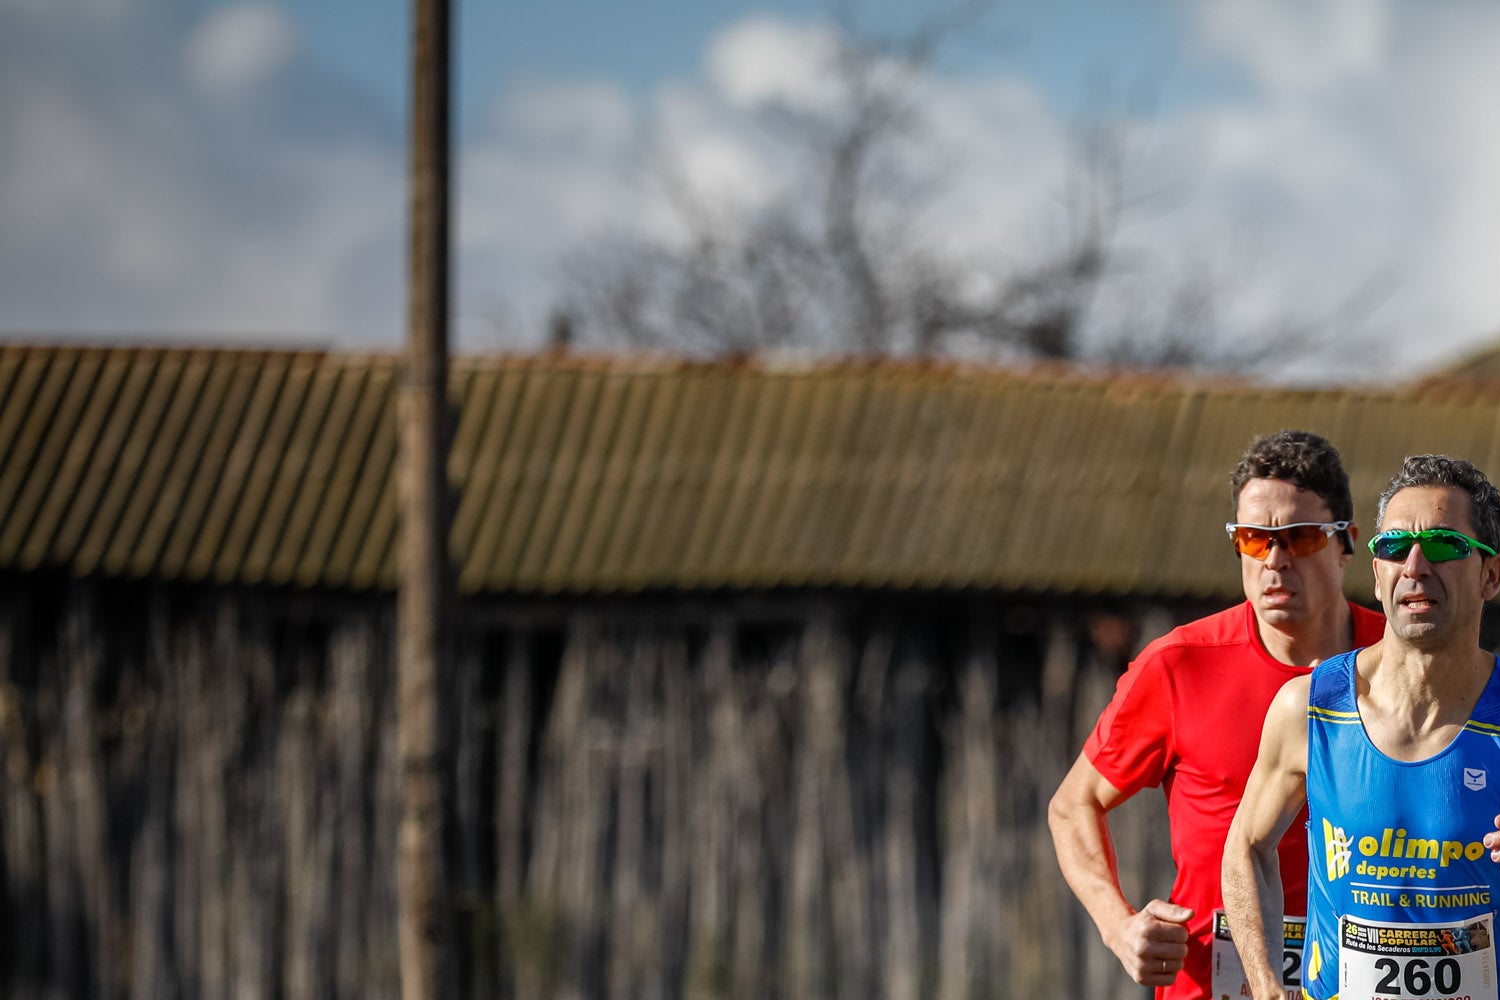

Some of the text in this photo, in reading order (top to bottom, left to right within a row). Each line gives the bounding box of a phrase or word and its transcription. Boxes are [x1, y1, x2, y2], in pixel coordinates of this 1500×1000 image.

[1358, 828, 1485, 867] olimpo
[1356, 860, 1437, 880] deportes
[1351, 889, 1490, 908] TRAIL & RUNNING
[1345, 922, 1358, 935] 26
[1366, 927, 1379, 943] VII
[1378, 928, 1437, 939] CARRERA
[1345, 938, 1358, 948] Ruta
[1358, 941, 1367, 949] de
[1366, 943, 1377, 951] los
[1377, 945, 1411, 953] Secaderos
[1379, 937, 1437, 946] POPULAR
[1374, 957, 1462, 996] 260
